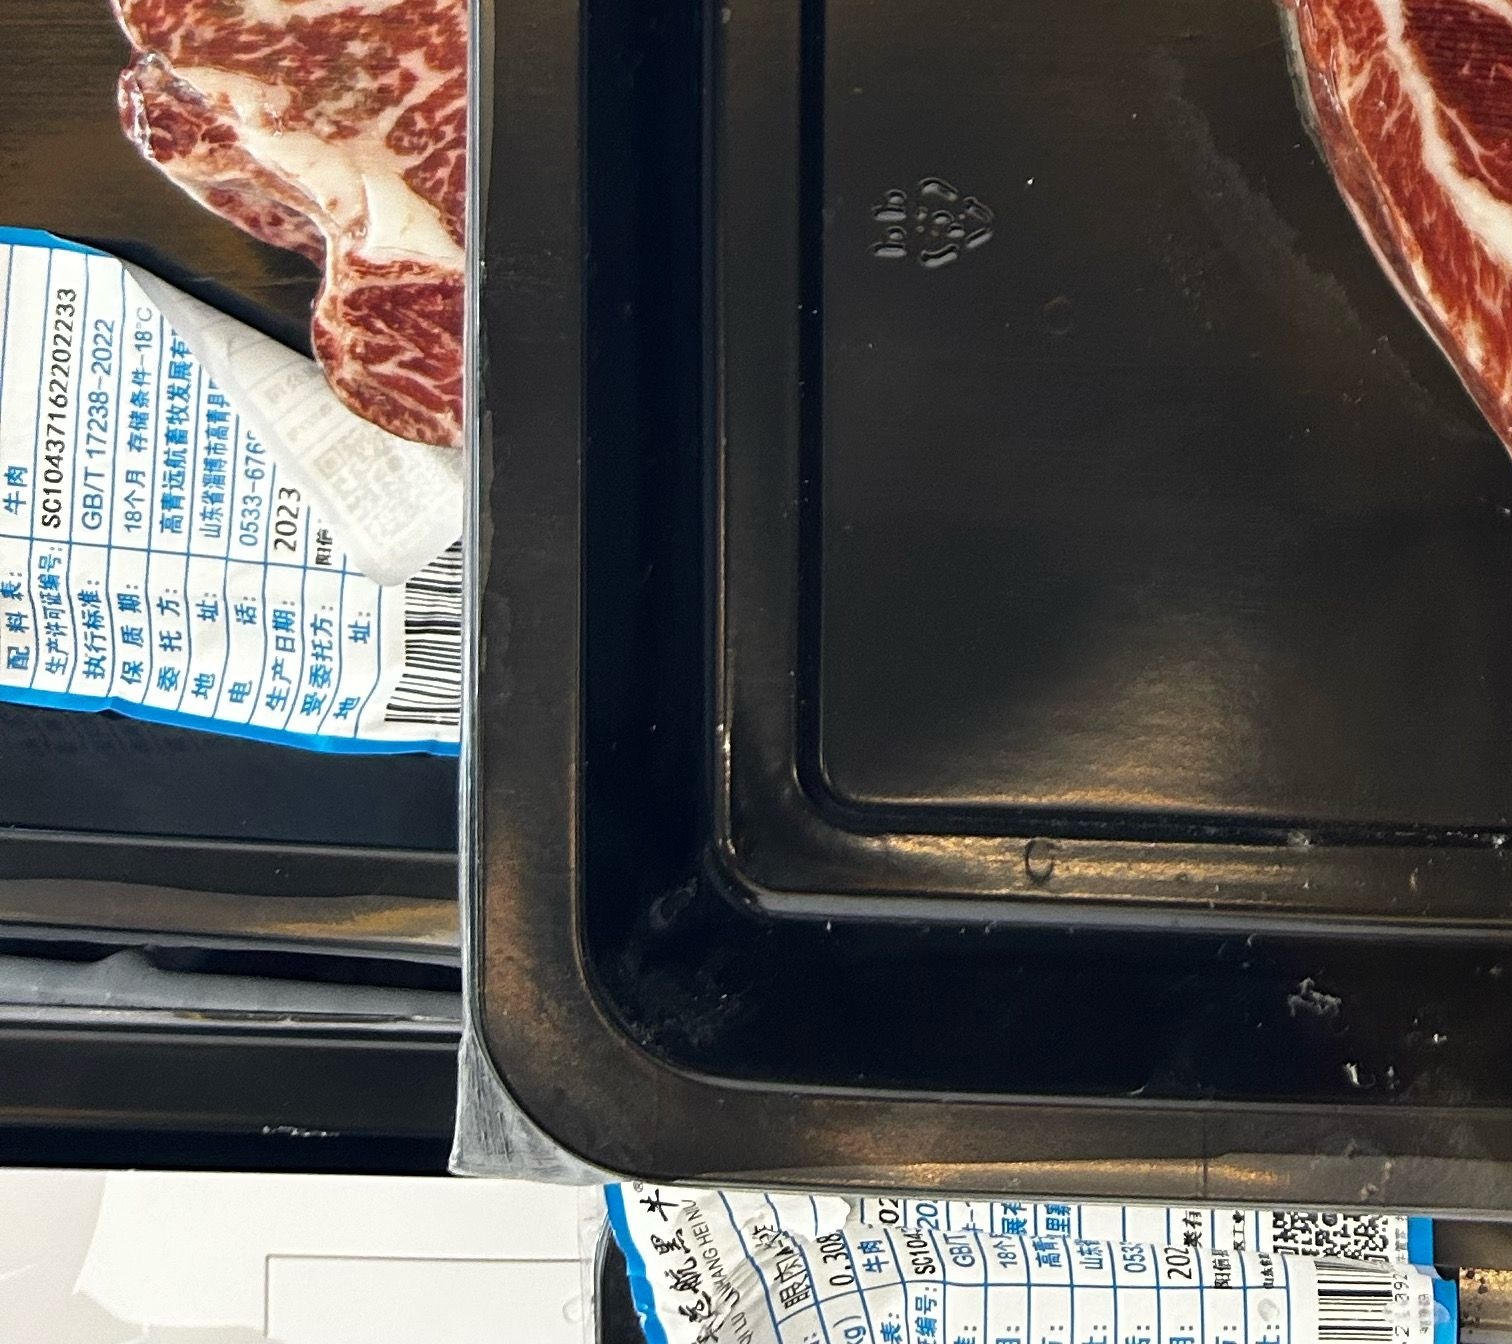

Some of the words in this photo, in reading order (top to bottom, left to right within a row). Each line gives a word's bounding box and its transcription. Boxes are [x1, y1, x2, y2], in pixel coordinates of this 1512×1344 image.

[41, 288, 76, 528] SC10437162202233
[86, 319, 115, 459] 17238-2022
[160, 329, 193, 534] 高青远航畜牧发展有
[4, 465, 28, 513] 牛肉
[82, 466, 105, 530] GB/T
[123, 470, 145, 533] 18个月
[858, 1240, 889, 1273] 牛肉
